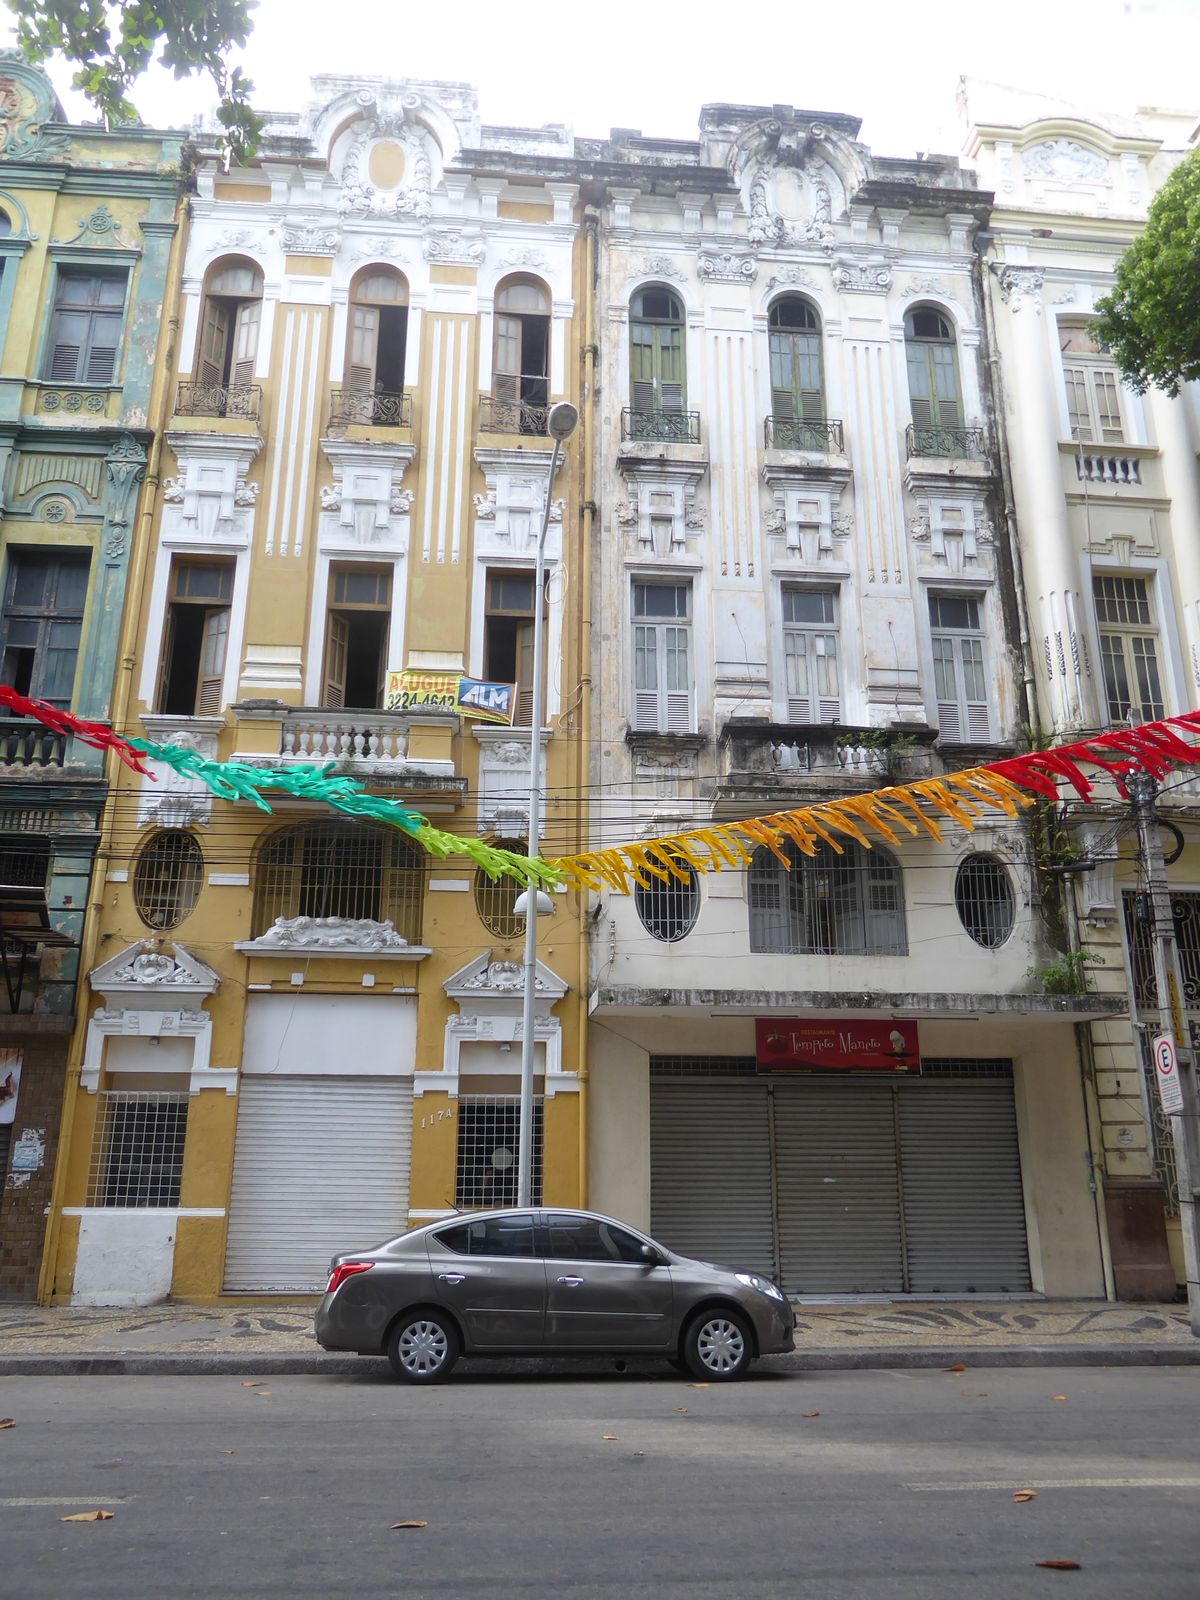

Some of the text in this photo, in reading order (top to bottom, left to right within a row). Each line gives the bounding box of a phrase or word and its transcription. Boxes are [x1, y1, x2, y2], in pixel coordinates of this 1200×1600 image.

[389, 673, 457, 694] ALUGUE
[461, 685, 509, 709] ALM
[790, 1032, 834, 1055] Tempero
[1162, 1048, 1169, 1068] E
[422, 1108, 452, 1129] 117A
